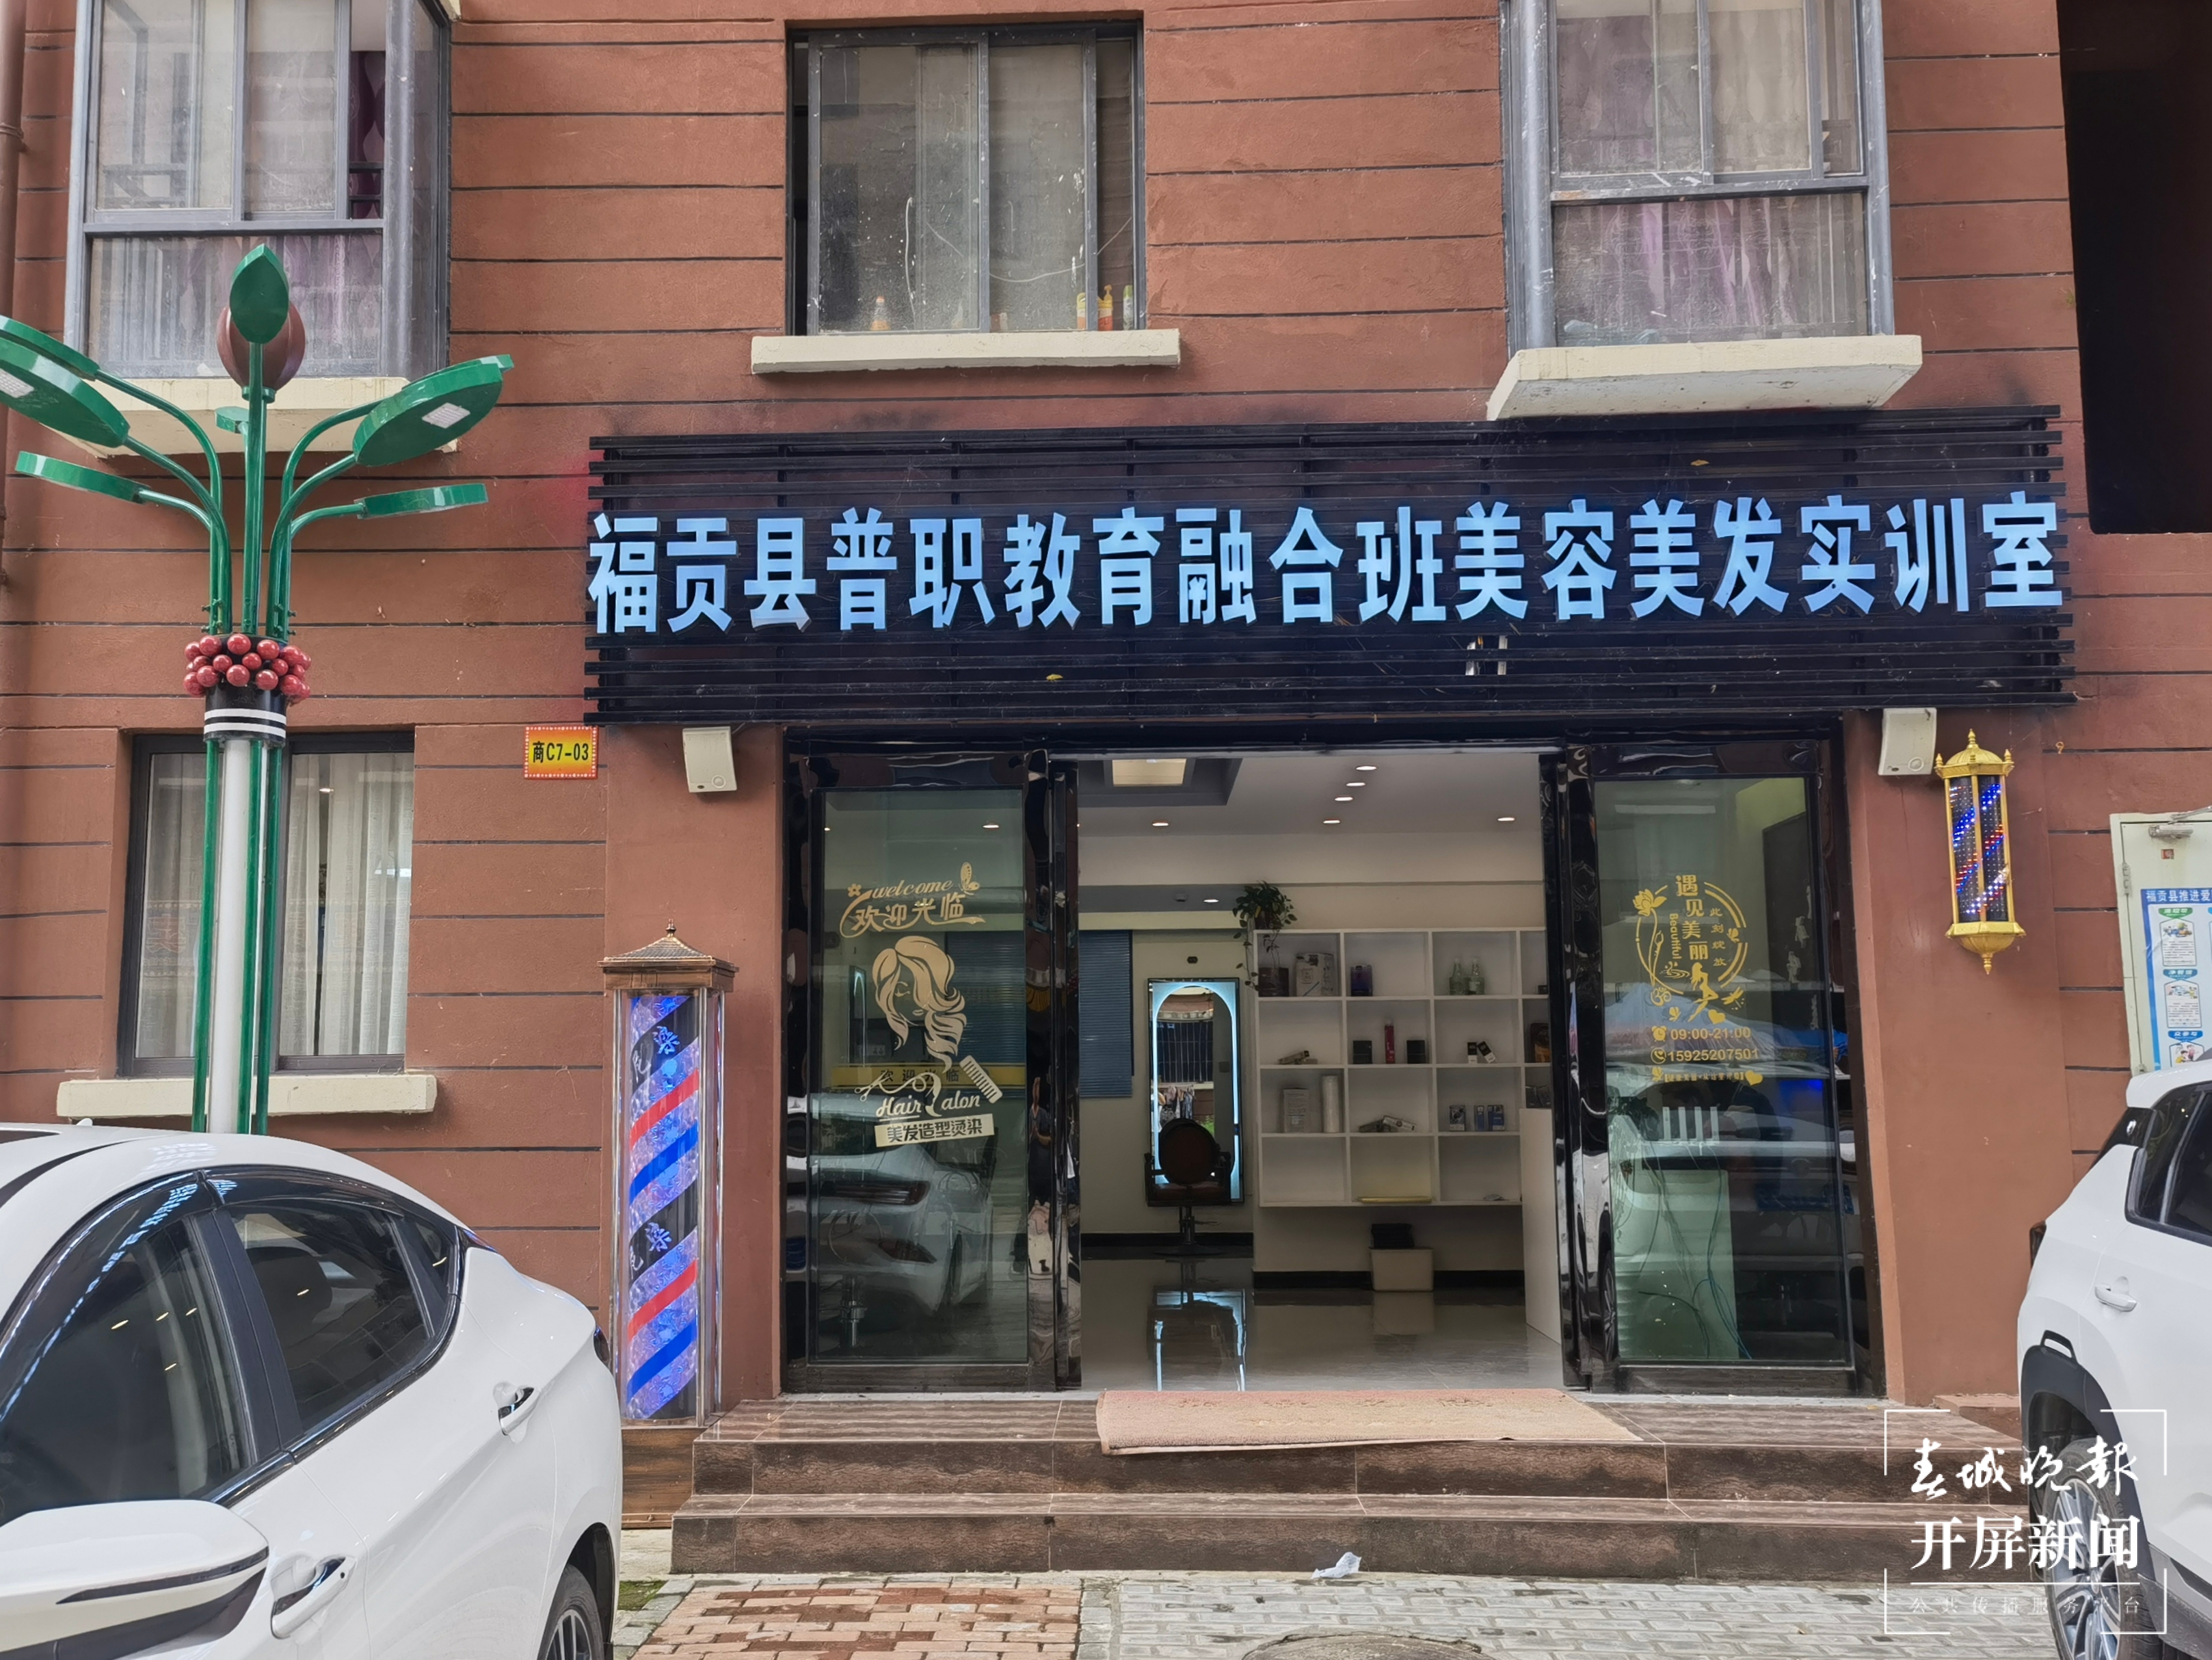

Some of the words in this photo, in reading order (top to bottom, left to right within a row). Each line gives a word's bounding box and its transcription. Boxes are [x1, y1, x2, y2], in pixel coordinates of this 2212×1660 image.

[588, 491, 2063, 634] 福贡县普职教育融合班美容美发实训室
[533, 741, 589, 763] 商C7-03
[872, 880, 953, 899] welcome
[849, 892, 969, 932] 欢迎光临
[1675, 875, 1709, 960] 遇见美丽
[1669, 913, 1682, 959] Beautiful
[1668, 1048, 1759, 1062] 15925207501
[875, 1095, 922, 1117] Hair
[886, 1118, 983, 1143] 美发造型烫染
